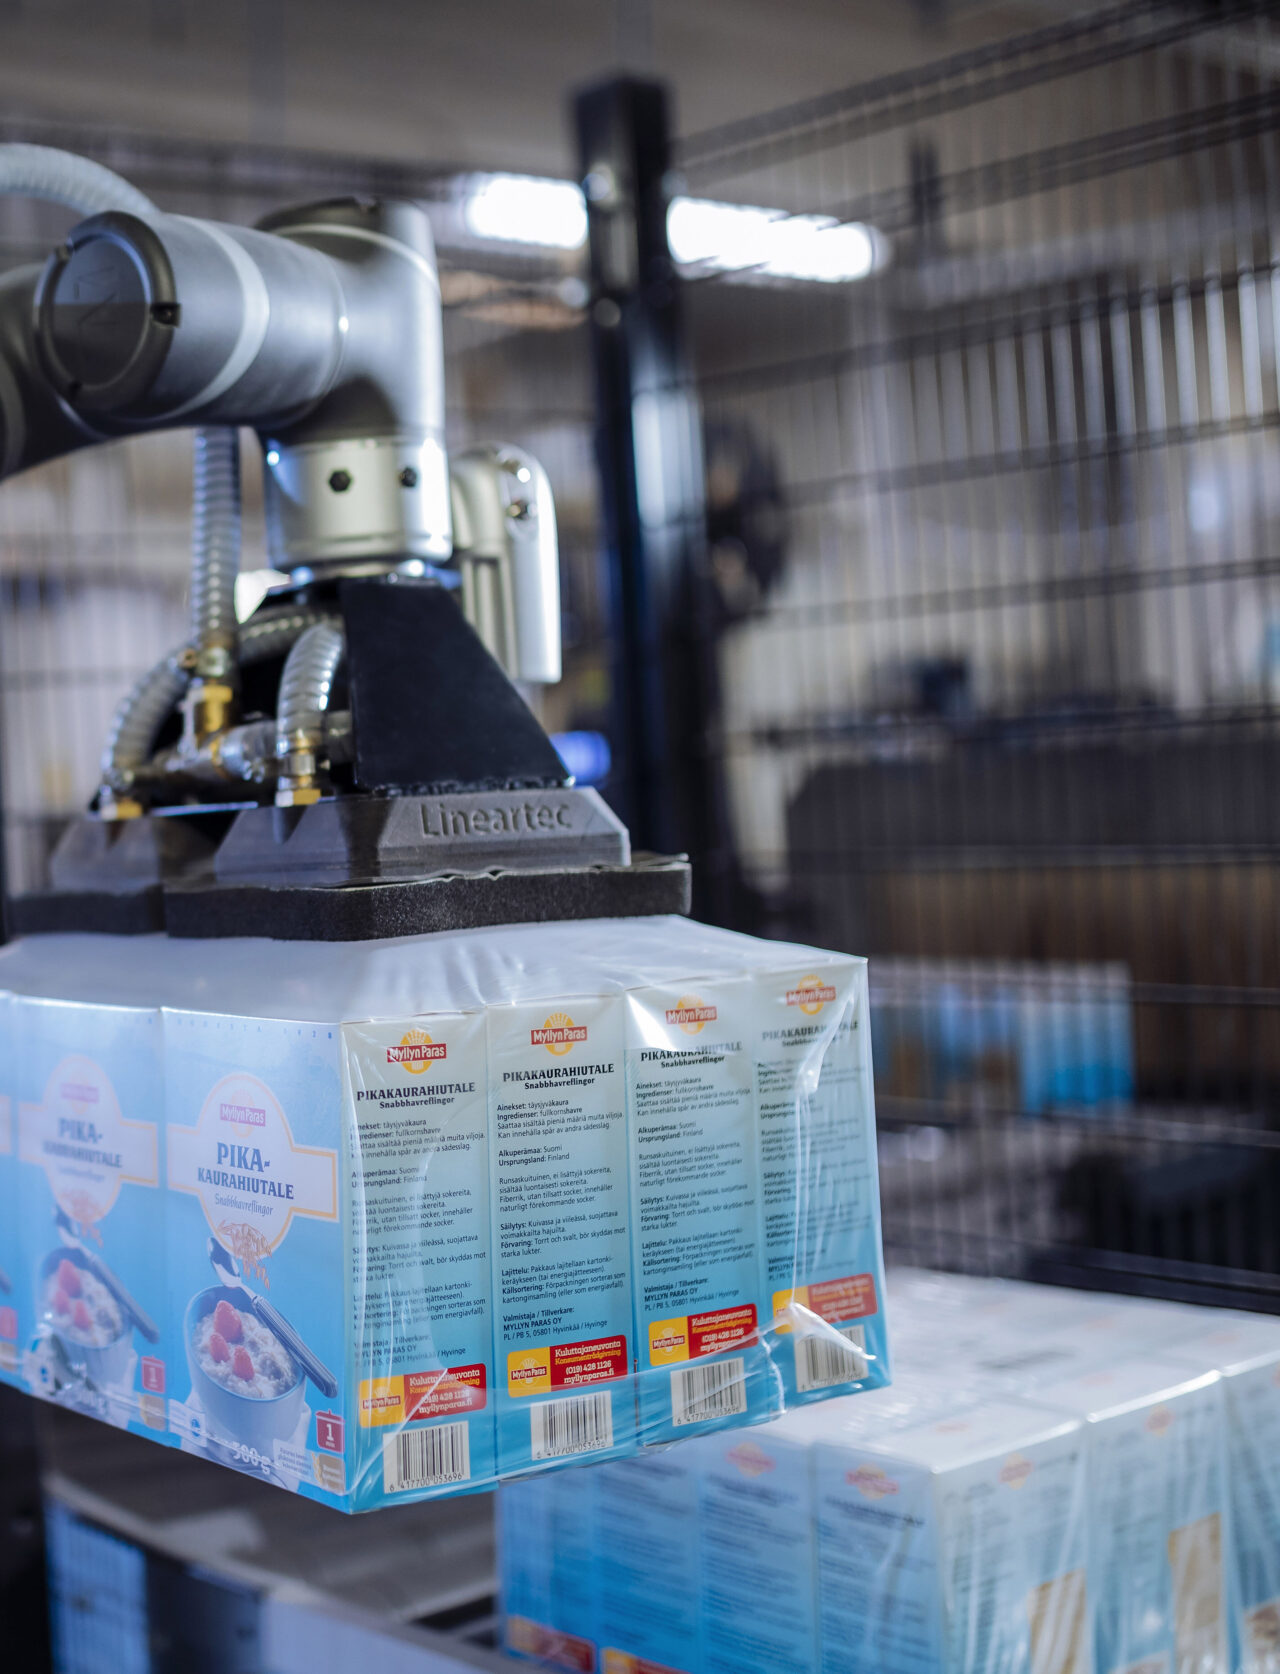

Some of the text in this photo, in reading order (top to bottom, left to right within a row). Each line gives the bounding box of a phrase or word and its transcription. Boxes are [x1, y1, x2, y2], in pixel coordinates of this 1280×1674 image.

[422, 803, 572, 836] Lineartec
[421, 1045, 444, 1057] Paras
[503, 1064, 614, 1082] PIKAKAURAHIUTALE
[525, 1078, 594, 1090] Snabbhavreflingor
[497, 1103, 526, 1111] Ainekset:
[497, 1107, 582, 1121] Ingredienser: fullkornshavre
[546, 1117, 565, 1126] pieniä
[512, 1129, 540, 1137] innehålla
[216, 1142, 270, 1172] PIKA-
[499, 1148, 541, 1157] Alkuperämaa:
[498, 1153, 569, 1167] Ursprungsland: Finland
[198, 1167, 294, 1200] KAURAHIUTALE
[499, 1174, 551, 1185] Runsaskuituinen,
[560, 1170, 582, 1178] lisättyjä
[499, 1186, 522, 1194] sisältää
[524, 1182, 558, 1191] luontaisesti
[499, 1194, 525, 1203] Fiberrik,
[585, 1184, 612, 1192] innehåller
[500, 1203, 527, 1212] naturligt
[529, 1198, 575, 1209] förekommande
[500, 1222, 526, 1231] Säilytys:
[528, 1219, 553, 1227] Kuivassa
[562, 1214, 587, 1223] viileässä,
[589, 1211, 617, 1220] suojattava
[501, 1227, 566, 1239] voimakkailta hajuilta.
[501, 1240, 532, 1249] Förvaring:
[591, 1229, 612, 1238] skyddas
[501, 1250, 520, 1258] starka
[501, 1267, 529, 1277] Lajittelu:
[557, 1260, 585, 1270] lajitellaan
[502, 1276, 536, 1285] keräykseen
[502, 1284, 544, 1294] Källsortering:
[545, 1278, 588, 1289] Förpackningen
[590, 1274, 612, 1282] sorteras
[502, 1291, 556, 1304] kartonginsamling
[503, 1312, 535, 1322] Valmistaja
[541, 1307, 574, 1316] Tillverkare:
[503, 1322, 529, 1331] MYLLYN
[531, 1318, 551, 1327] PARAS
[533, 1328, 550, 1336] 05801
[553, 1324, 579, 1334] Hyvinkää
[584, 1320, 607, 1329] Hyvinge
[555, 1341, 620, 1357] Kuluttajaneuvonta
[564, 1369, 614, 1384] myllynparas.fi
[566, 1365, 582, 1375] (019)
